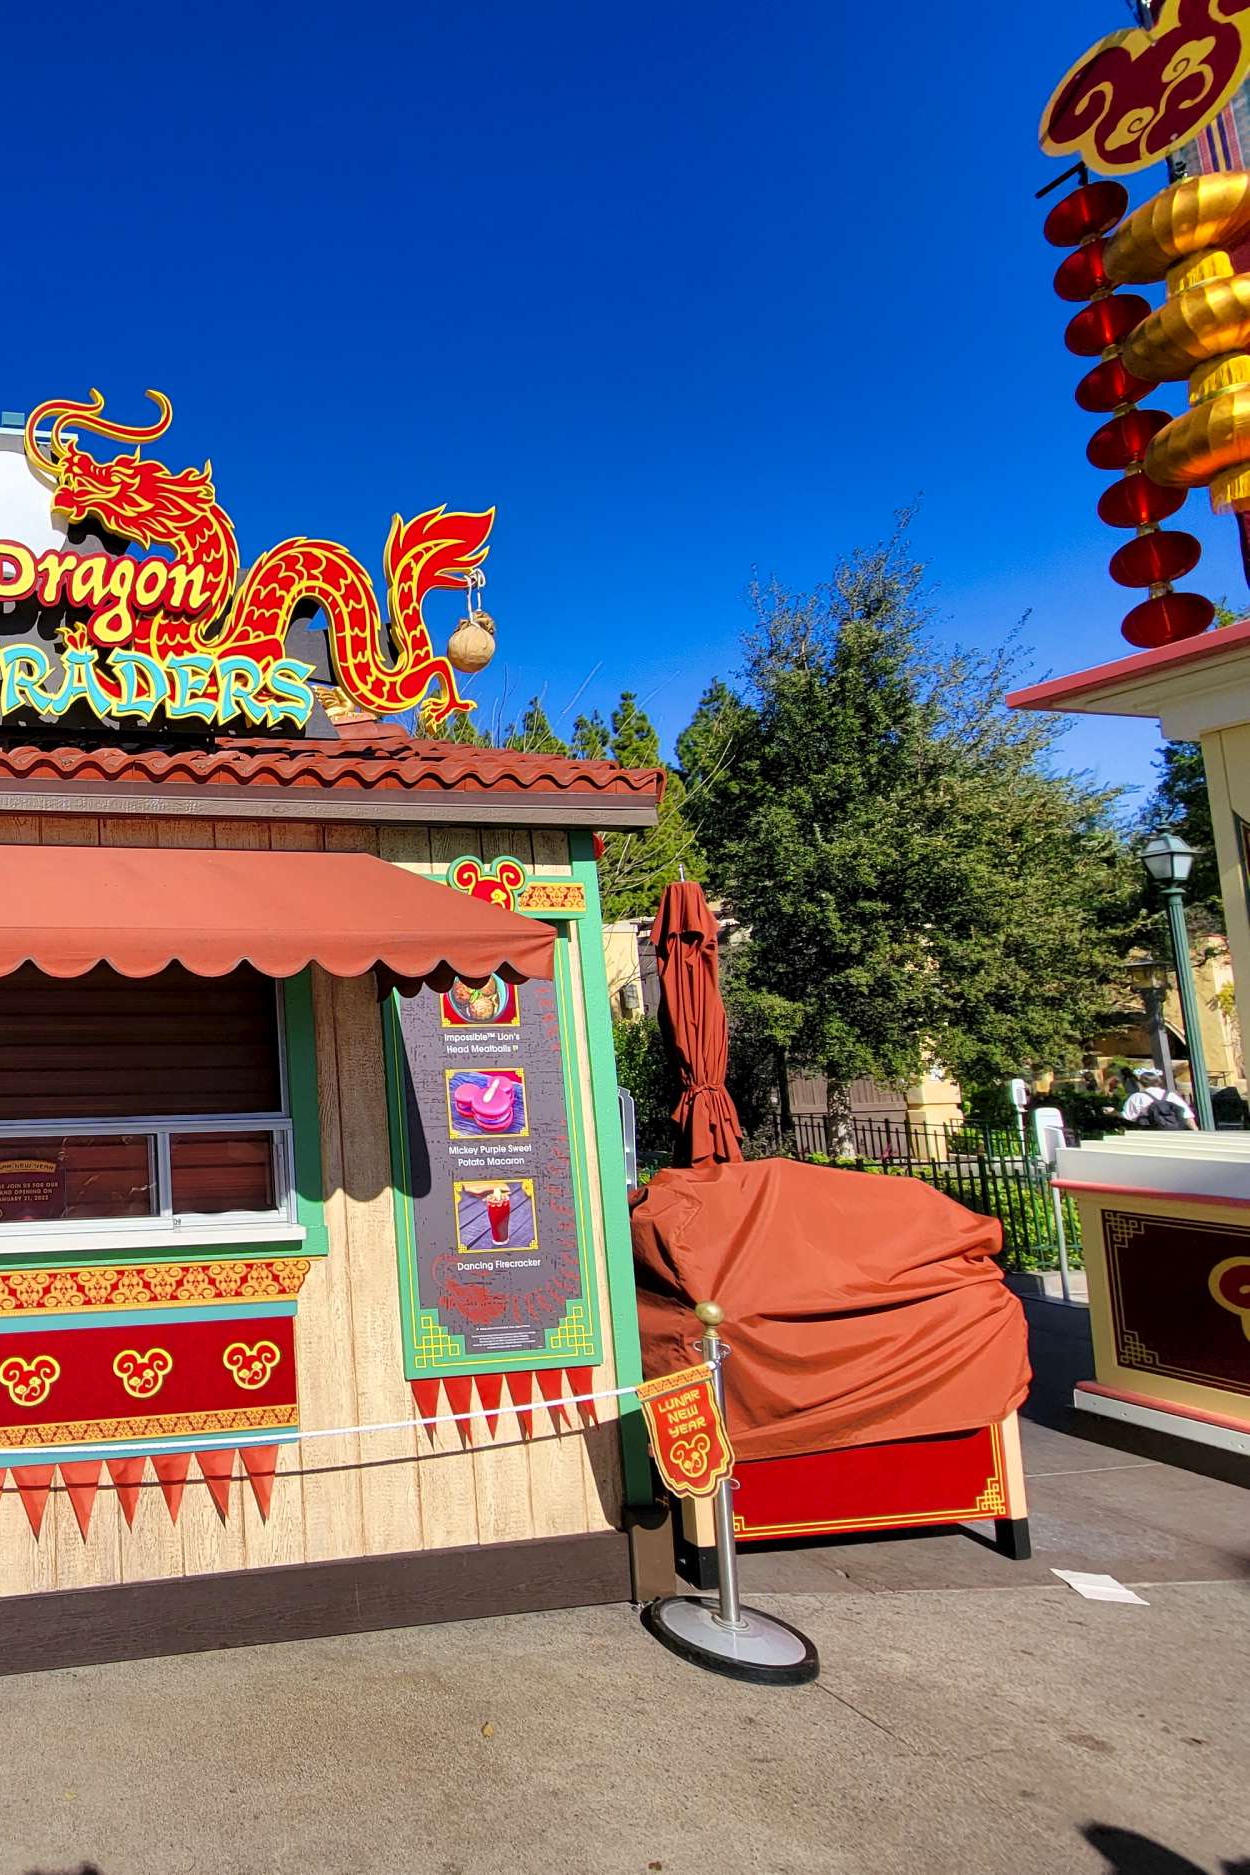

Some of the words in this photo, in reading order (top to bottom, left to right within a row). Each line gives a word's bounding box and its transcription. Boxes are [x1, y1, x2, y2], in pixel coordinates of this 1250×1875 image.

[497, 1033, 520, 1041] Lion's
[446, 1045, 469, 1053] Head
[471, 1044, 511, 1053] Meatballs
[448, 1146, 478, 1155] Mickey
[480, 1145, 506, 1154] Purple
[508, 1144, 532, 1152] Sweet
[458, 1158, 485, 1167] Potato
[487, 1157, 524, 1166] Macaron
[457, 1261, 493, 1271] Dancing
[495, 1258, 541, 1268] Firecracker
[657, 1389, 700, 1414] LUNAR
[667, 1403, 699, 1424] NEW
[668, 1416, 707, 1438] YEAR
